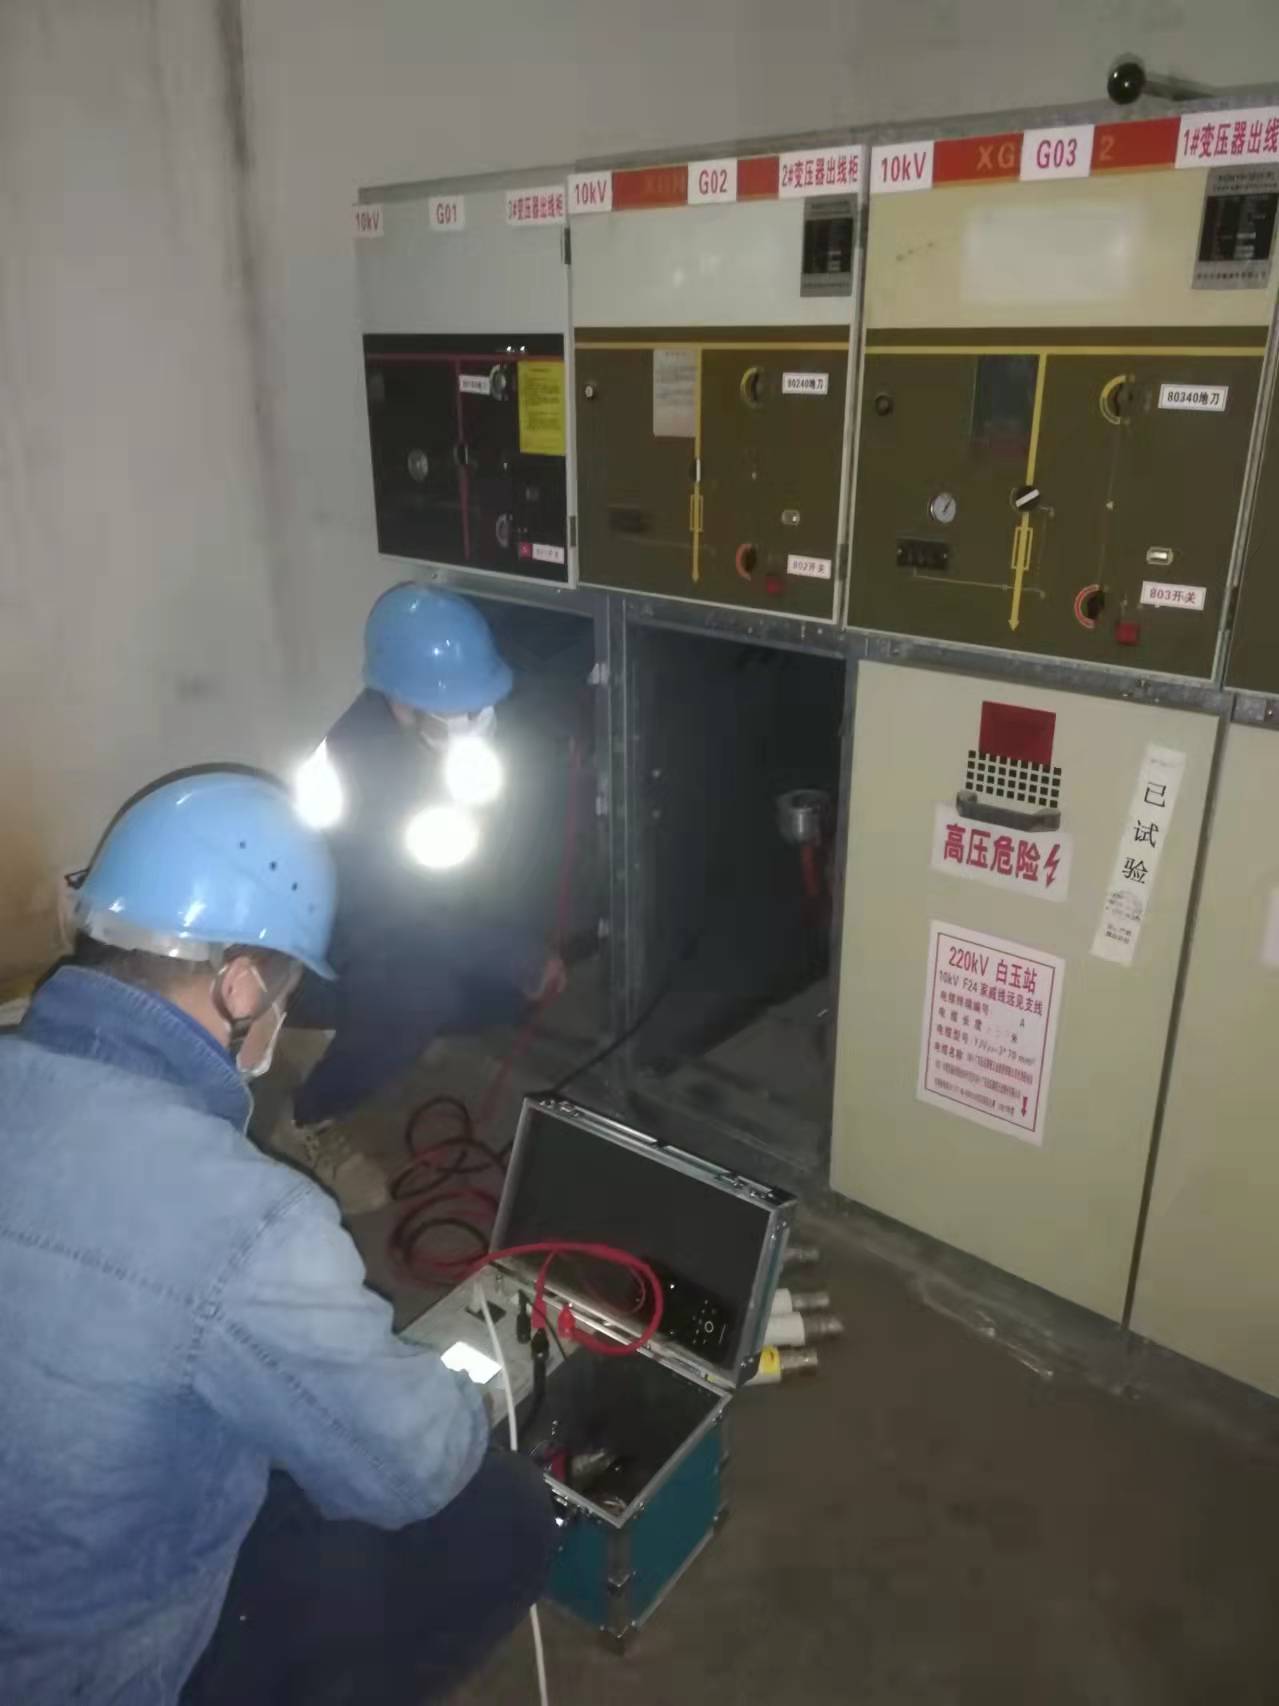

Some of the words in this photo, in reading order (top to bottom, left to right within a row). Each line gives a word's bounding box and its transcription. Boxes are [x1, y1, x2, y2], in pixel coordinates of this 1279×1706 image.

[1037, 138, 1077, 168] G03
[782, 155, 858, 187] 2#变压器出线柜
[882, 151, 926, 182] 10kV
[575, 180, 607, 204] 10kV
[699, 168, 728, 194] G02
[357, 210, 380, 232] 10kV
[437, 203, 457, 224] G01
[1167, 391, 1220, 405] 80340地刀
[1150, 587, 1196, 604] 803开关
[944, 823, 1041, 881] 高压危险
[948, 946, 989, 976] 220kV
[995, 959, 1037, 994] 白玉站
